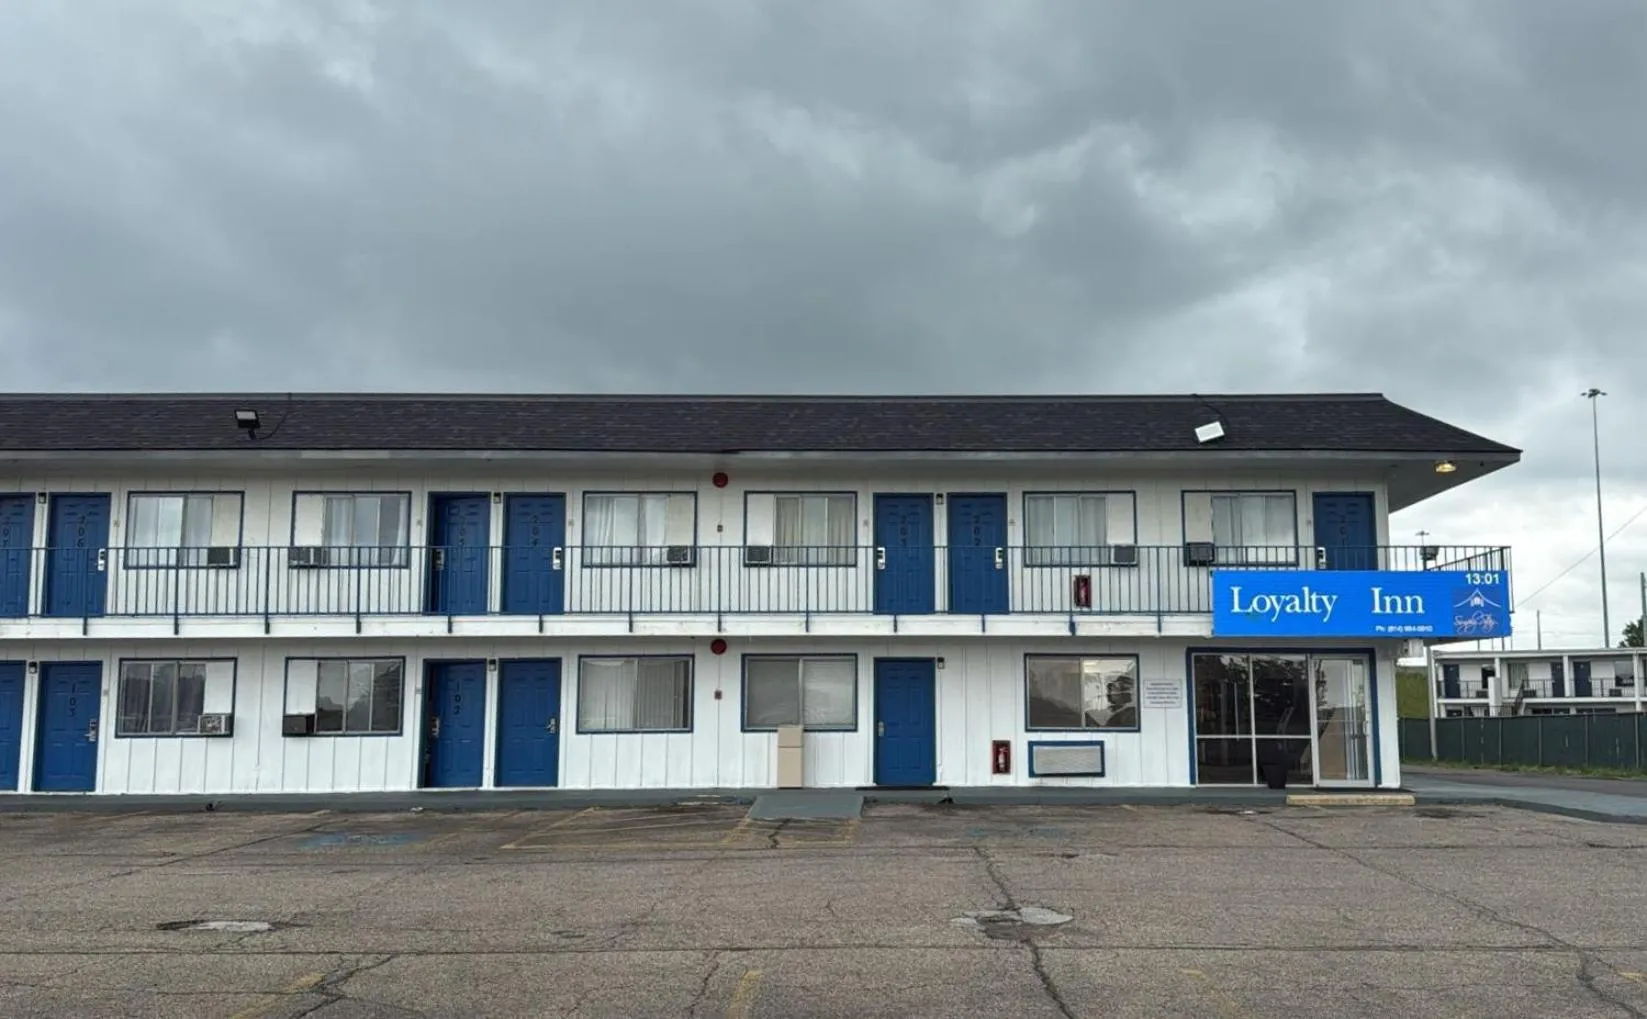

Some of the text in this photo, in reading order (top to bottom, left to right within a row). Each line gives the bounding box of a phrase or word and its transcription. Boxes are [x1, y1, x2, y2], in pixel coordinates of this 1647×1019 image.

[1466, 573, 1499, 585] 13:01
[1230, 586, 1425, 622] Loyalty Inn
